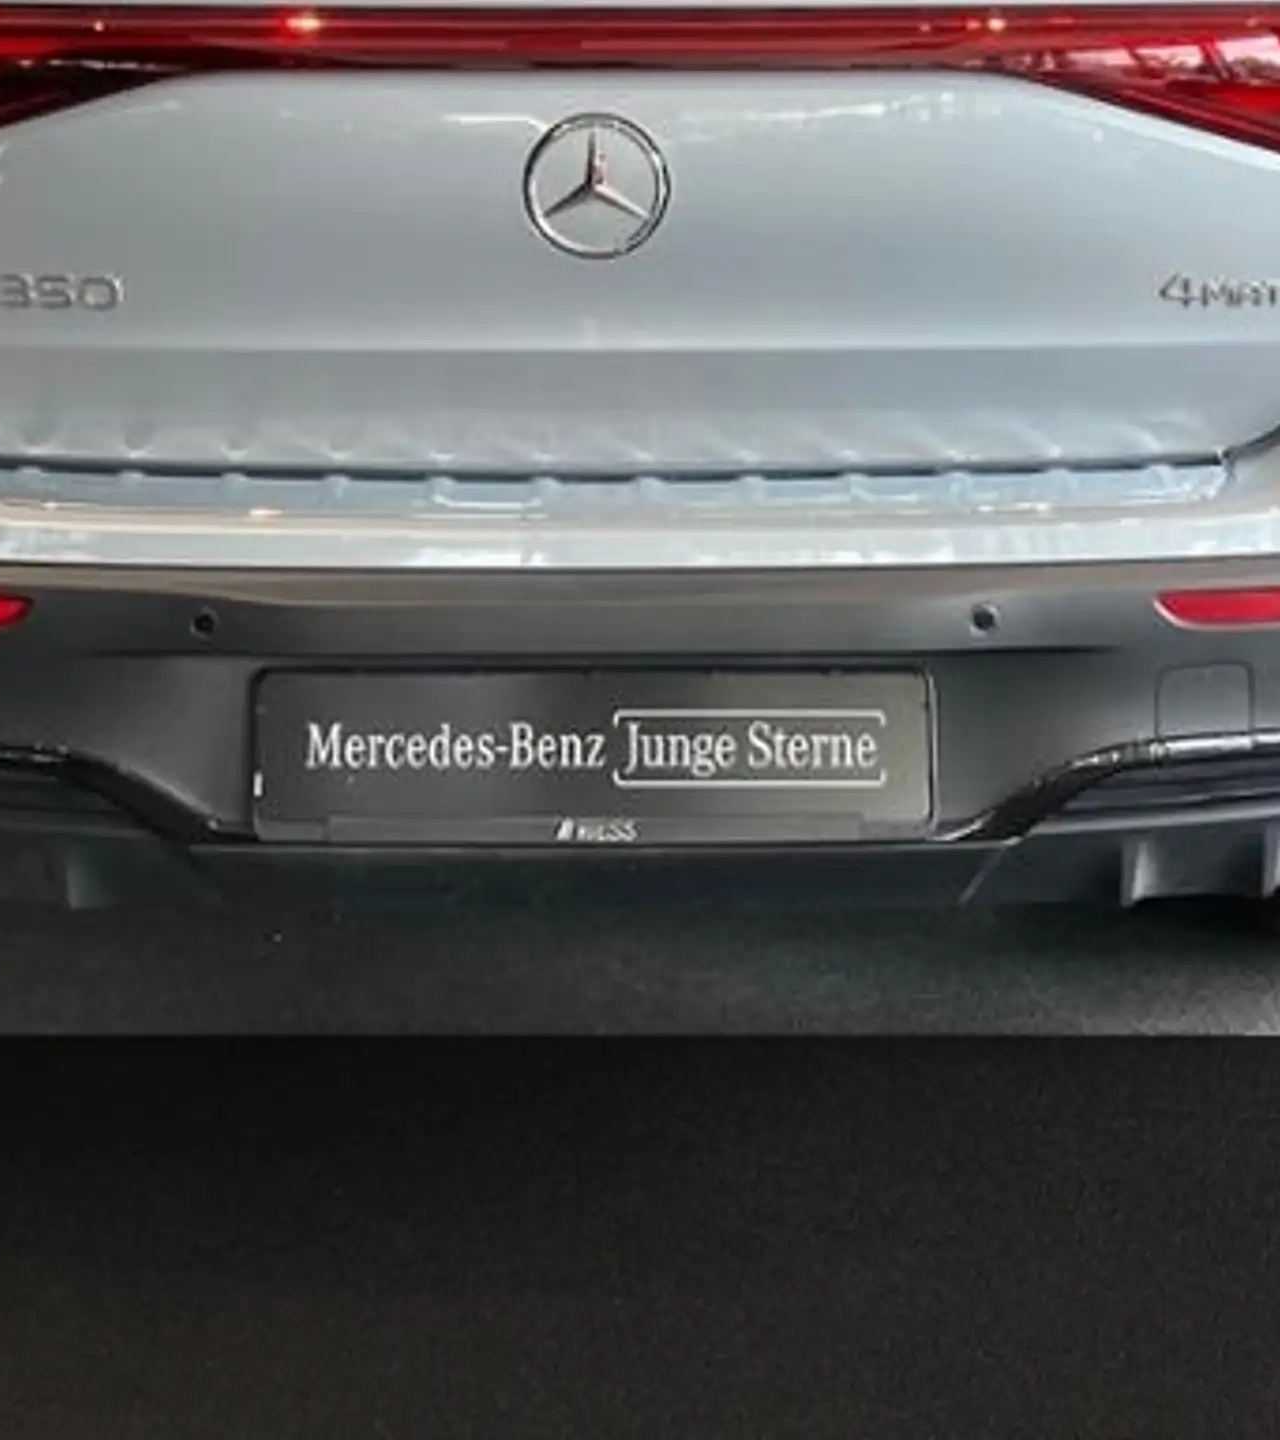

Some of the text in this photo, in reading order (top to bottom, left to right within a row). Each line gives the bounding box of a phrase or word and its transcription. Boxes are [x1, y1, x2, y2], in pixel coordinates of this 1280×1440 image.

[306, 720, 877, 778] Mercedes-Benz Junge Sterne
